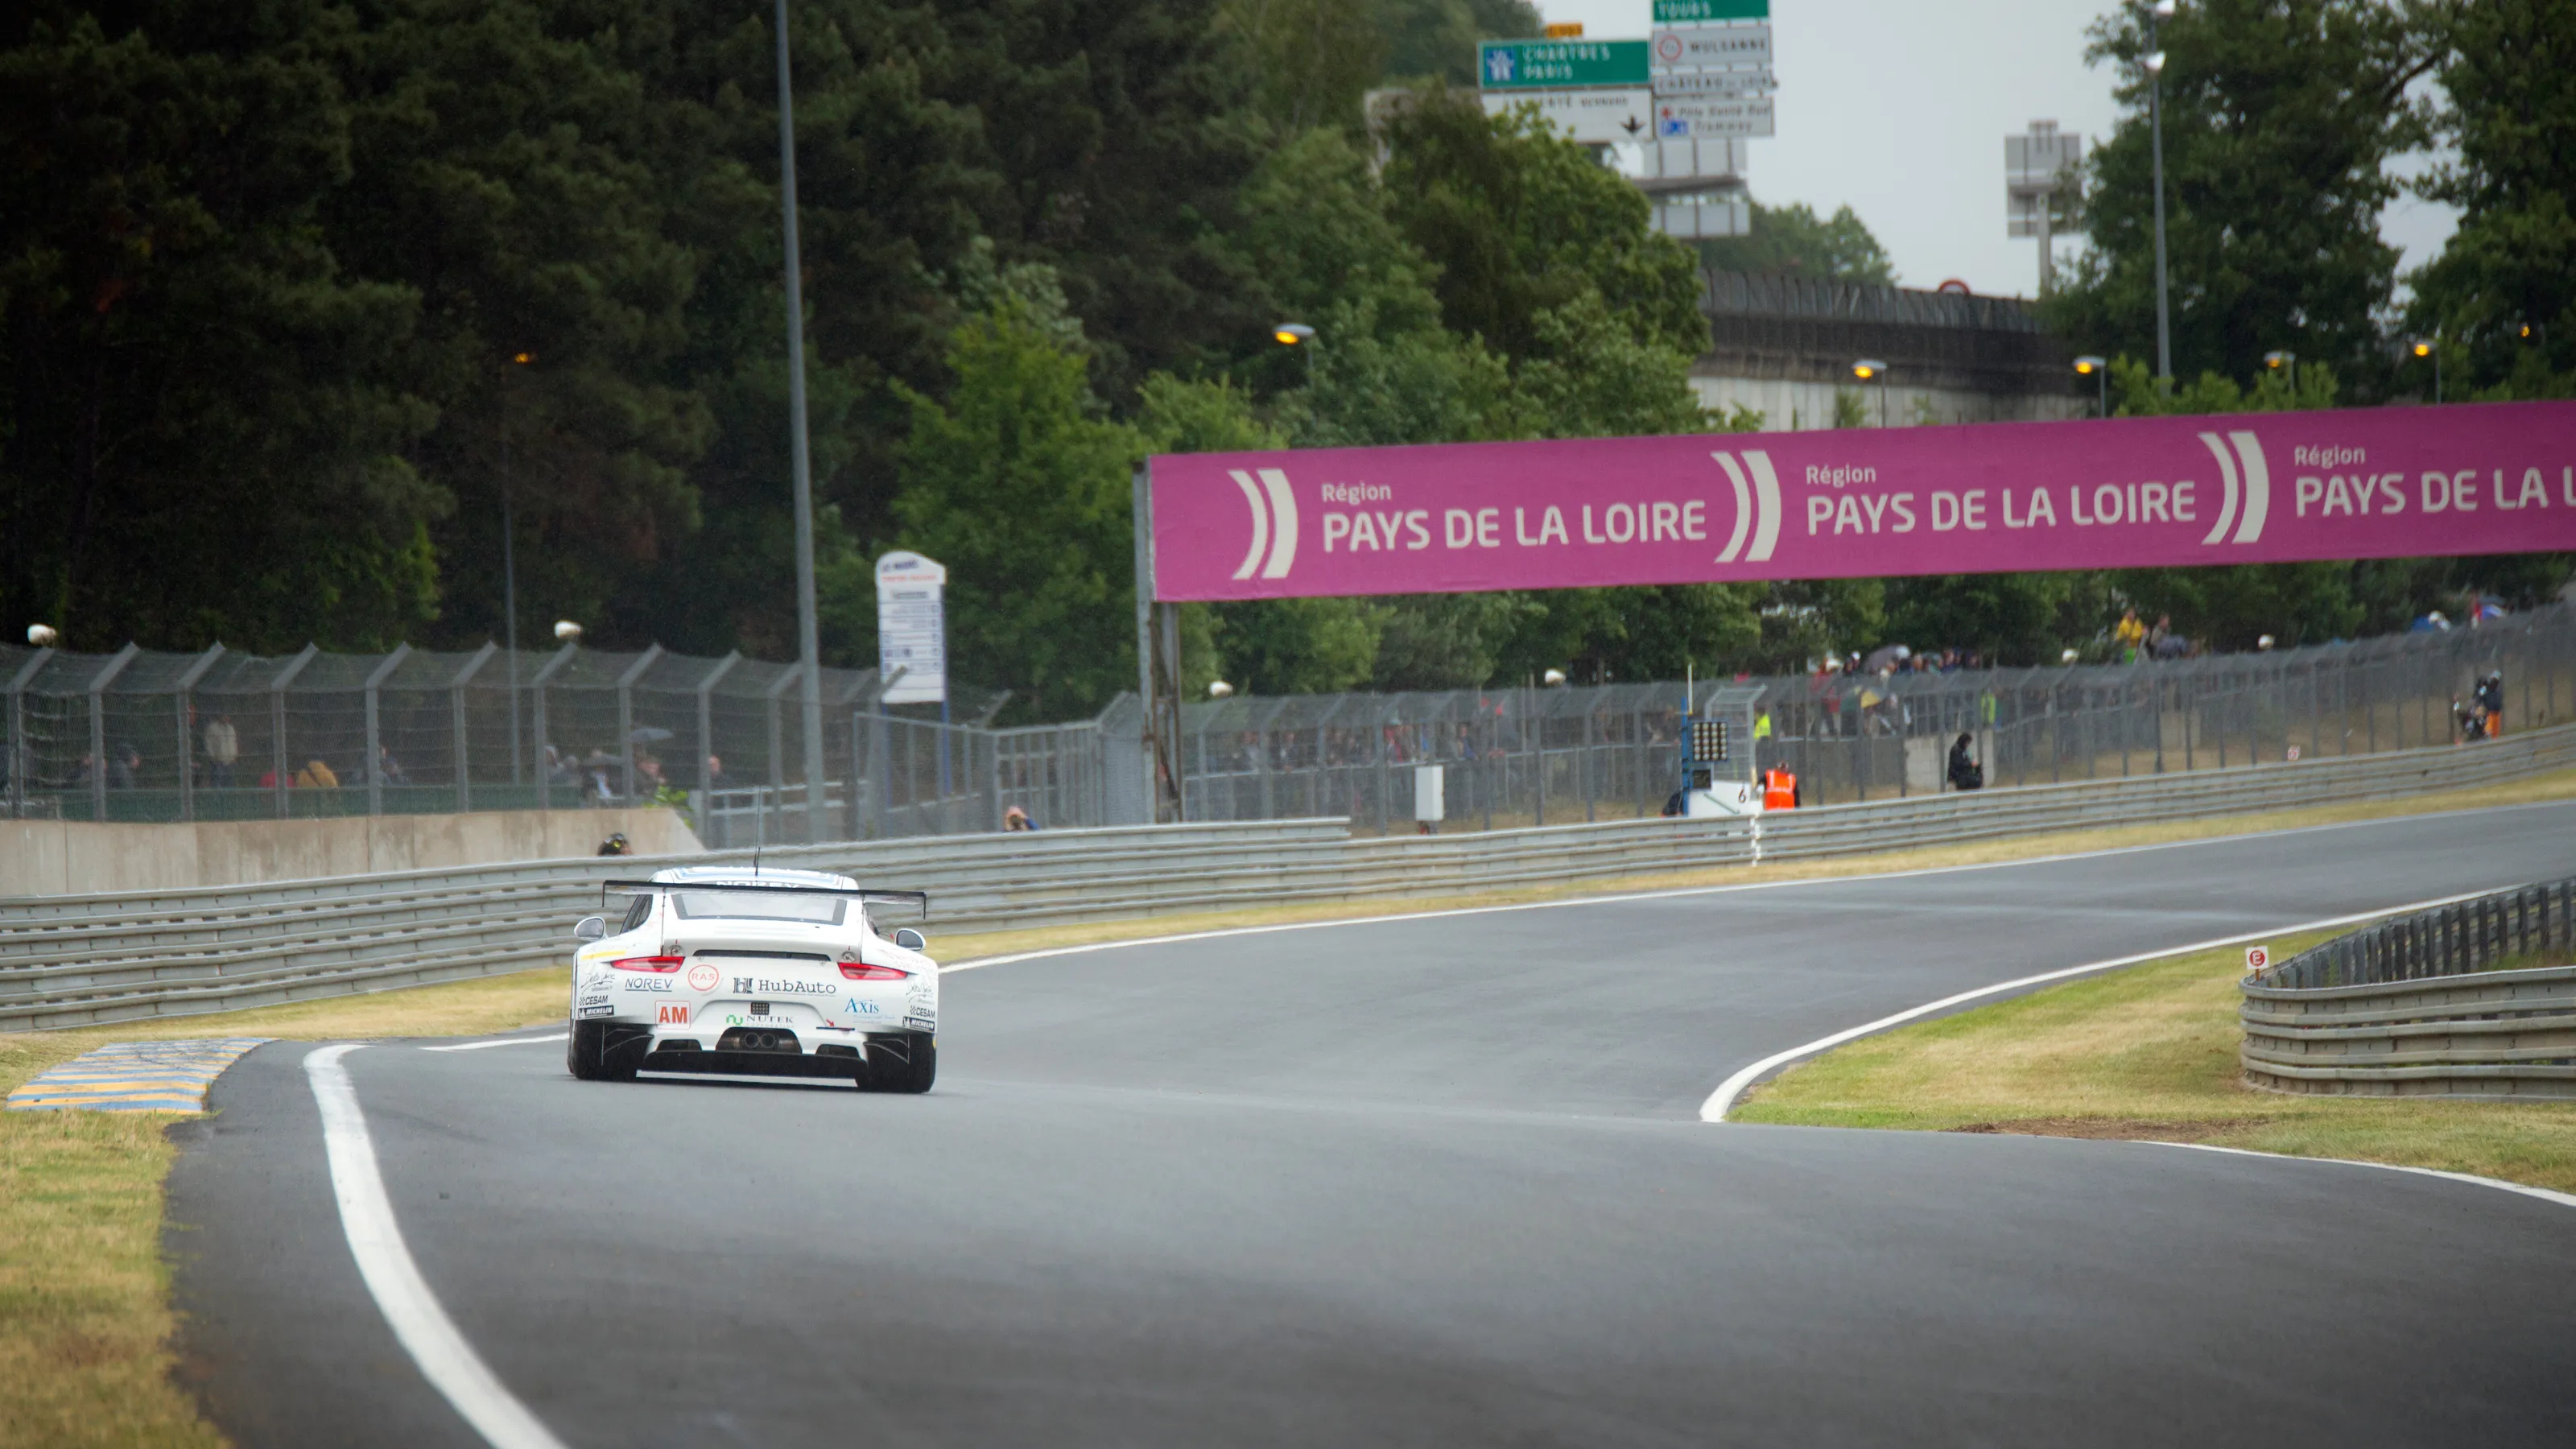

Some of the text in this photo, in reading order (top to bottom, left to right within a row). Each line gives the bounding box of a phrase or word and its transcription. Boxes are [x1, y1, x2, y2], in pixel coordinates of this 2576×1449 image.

[1523, 44, 1610, 60] CHARTRES
[1523, 64, 1573, 80] PARIS
[2294, 444, 2366, 469] Région
[1806, 463, 1876, 487] Région
[1321, 481, 1392, 506] Région
[2295, 473, 2406, 517] PAYS
[2421, 469, 2478, 513] DE
[2494, 468, 2549, 509] LA
[1807, 481, 2196, 535] PAYS DE LA LOIRE
[1323, 499, 1707, 553] PAYS DE LA LOIRE
[1739, 787, 1746, 803] 6
[2252, 952, 2263, 964] E
[625, 977, 673, 991] NOREV
[691, 972, 715, 982] RAS
[758, 978, 836, 995] HubAuto
[585, 995, 609, 1006] CESAM
[844, 997, 880, 1014] Axis
[586, 1006, 613, 1017] MICHELIN
[658, 1006, 688, 1024] AM
[746, 1014, 794, 1024] NUTEK
[915, 1007, 935, 1019] CESAM
[910, 1018, 935, 1030] MICHELIN
